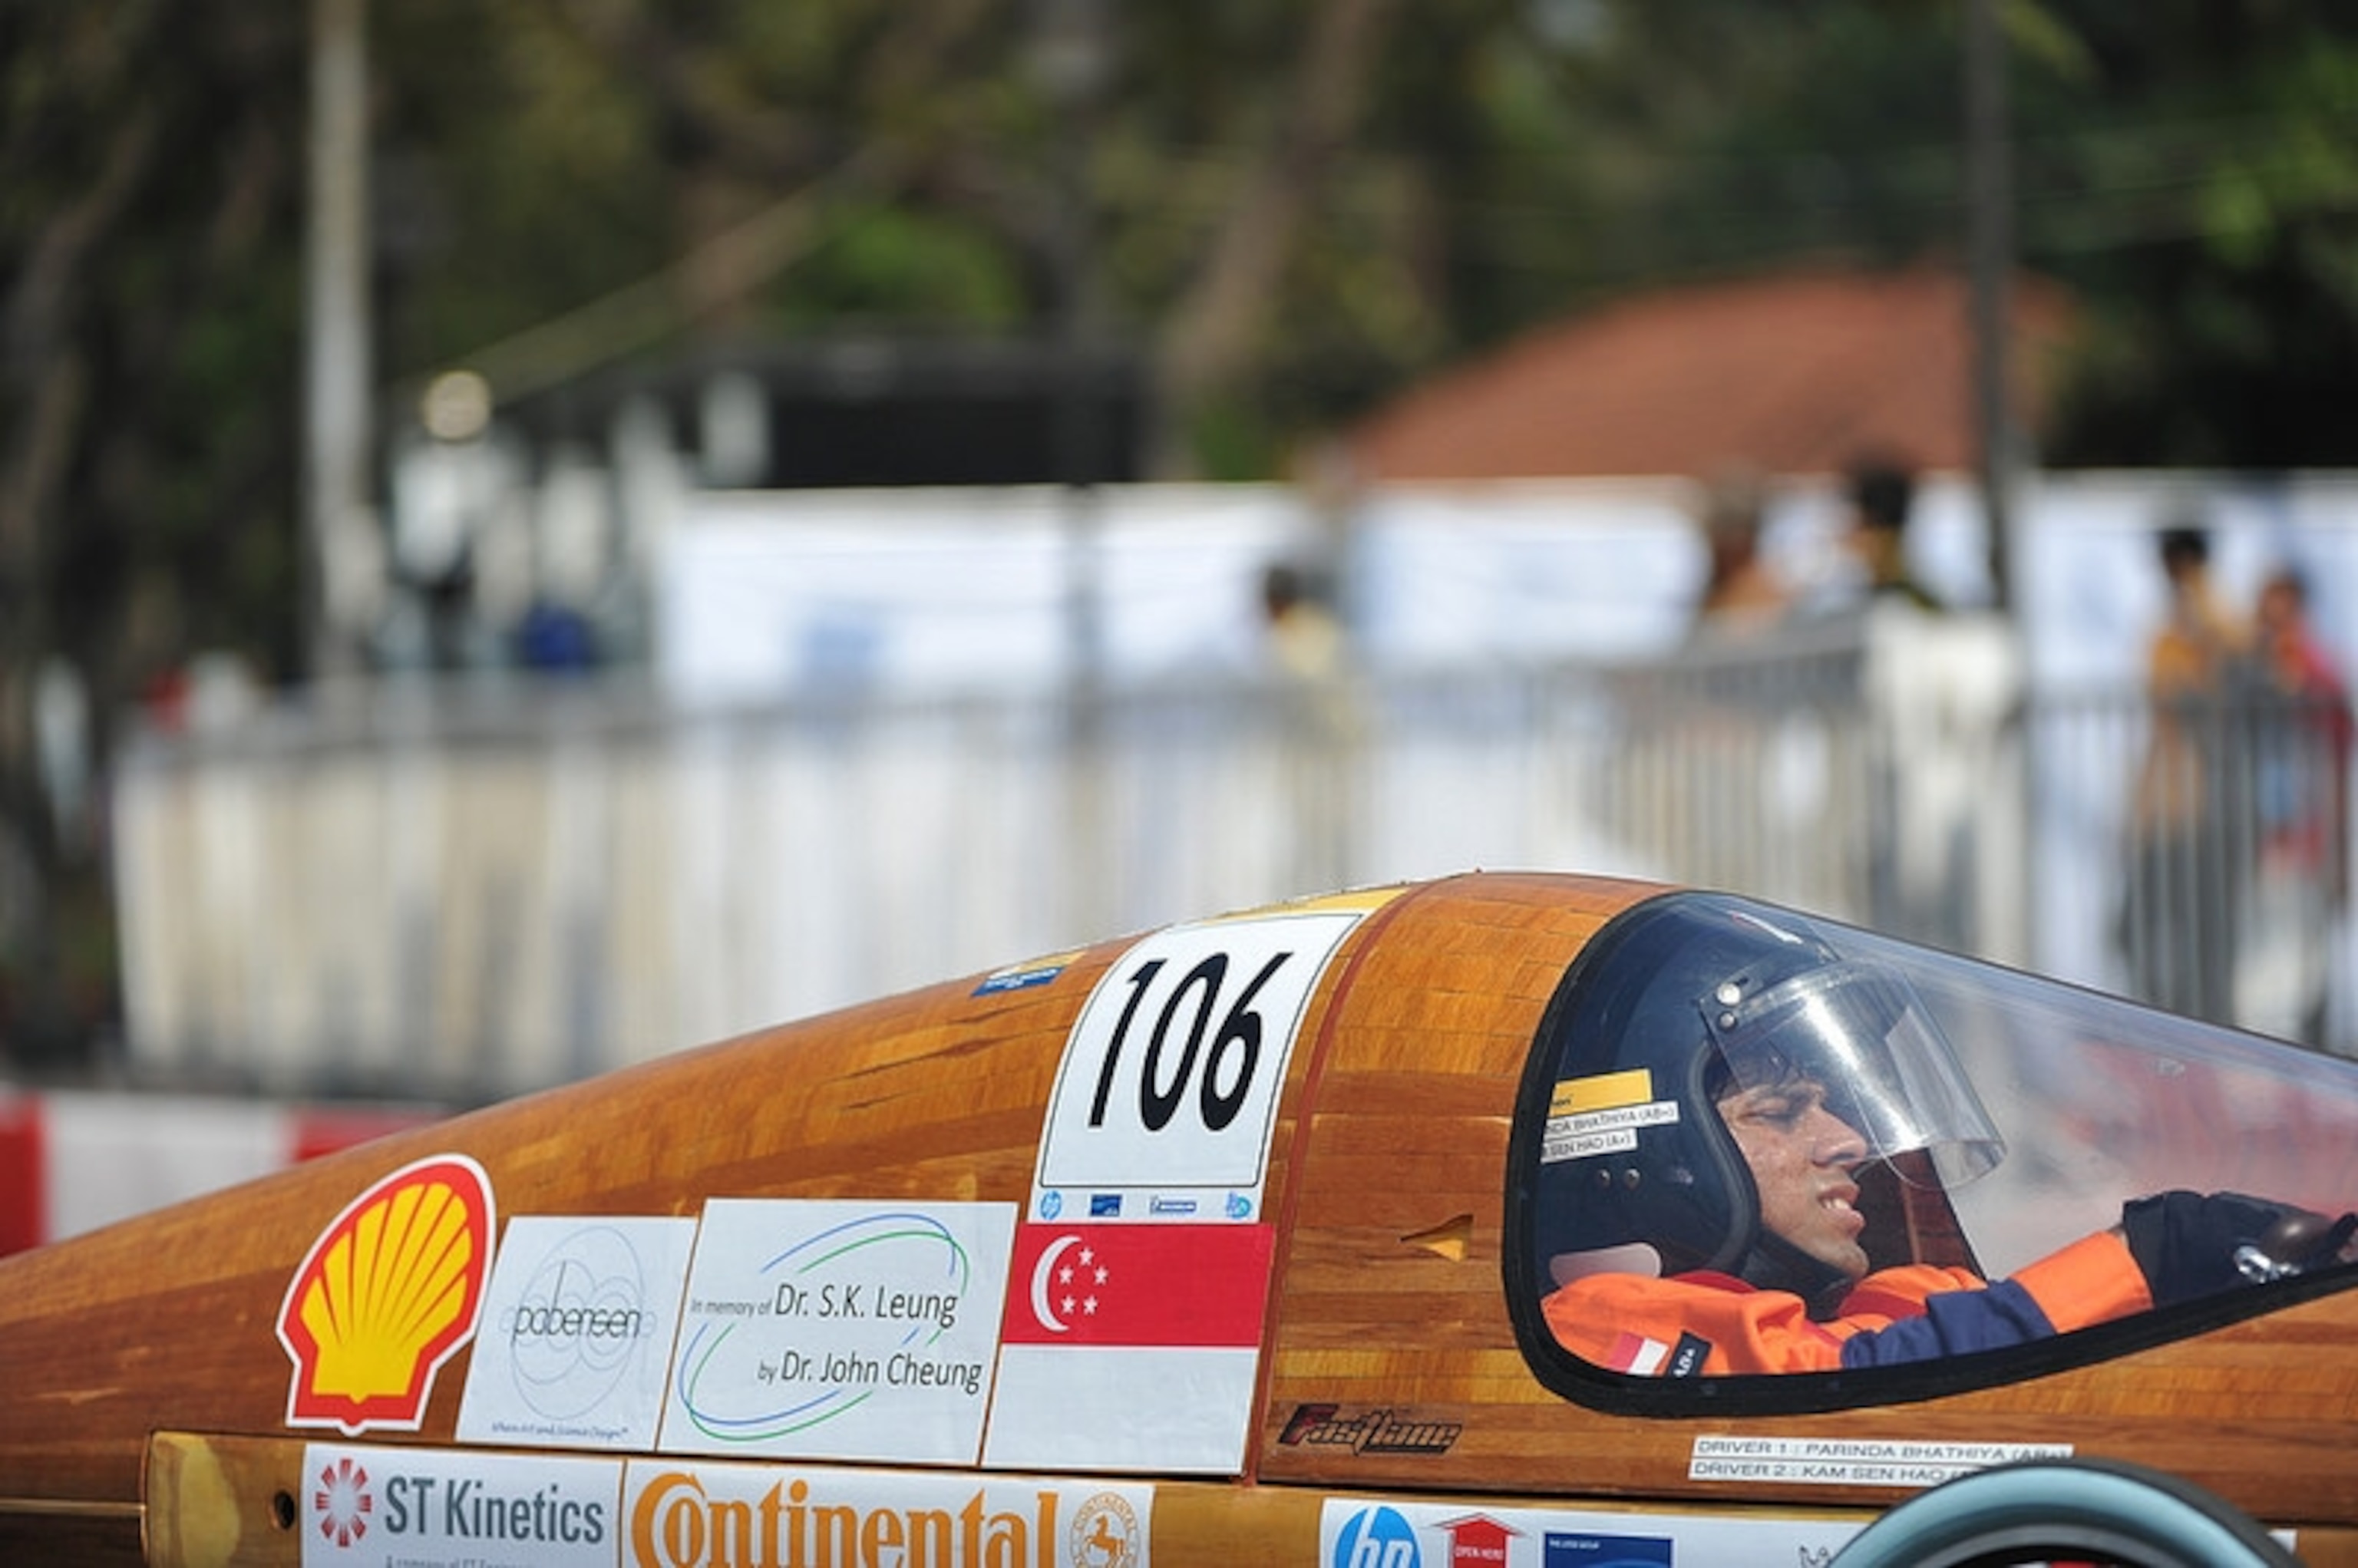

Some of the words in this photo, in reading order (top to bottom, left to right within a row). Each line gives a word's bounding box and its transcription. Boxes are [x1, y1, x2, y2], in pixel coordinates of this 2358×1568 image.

[1088, 952, 1293, 1132] 106
[705, 1300, 755, 1319] memory
[758, 1297, 773, 1315] of
[775, 1283, 809, 1317] Dr.
[819, 1284, 866, 1319] S.K.
[877, 1285, 959, 1329] Leung
[758, 1359, 778, 1385] by
[781, 1351, 812, 1382] Dr.
[819, 1352, 880, 1385] John
[886, 1353, 982, 1395] Cheung
[1694, 1461, 1767, 1475] DRIVER
[1773, 1464, 1786, 1477] 2
[1803, 1464, 1846, 1479] KAM
[1852, 1467, 1894, 1481] SEN
[1901, 1468, 1945, 1482] HAO
[1698, 1440, 1772, 1454] DRIVER
[1778, 1442, 1787, 1454] 1
[1806, 1443, 1896, 1457] PARINDA
[1901, 1445, 2005, 1459] BHATHIYA
[385, 1475, 435, 1535] ST
[445, 1478, 604, 1545] Kinetics
[631, 1471, 1058, 1568] Continental
